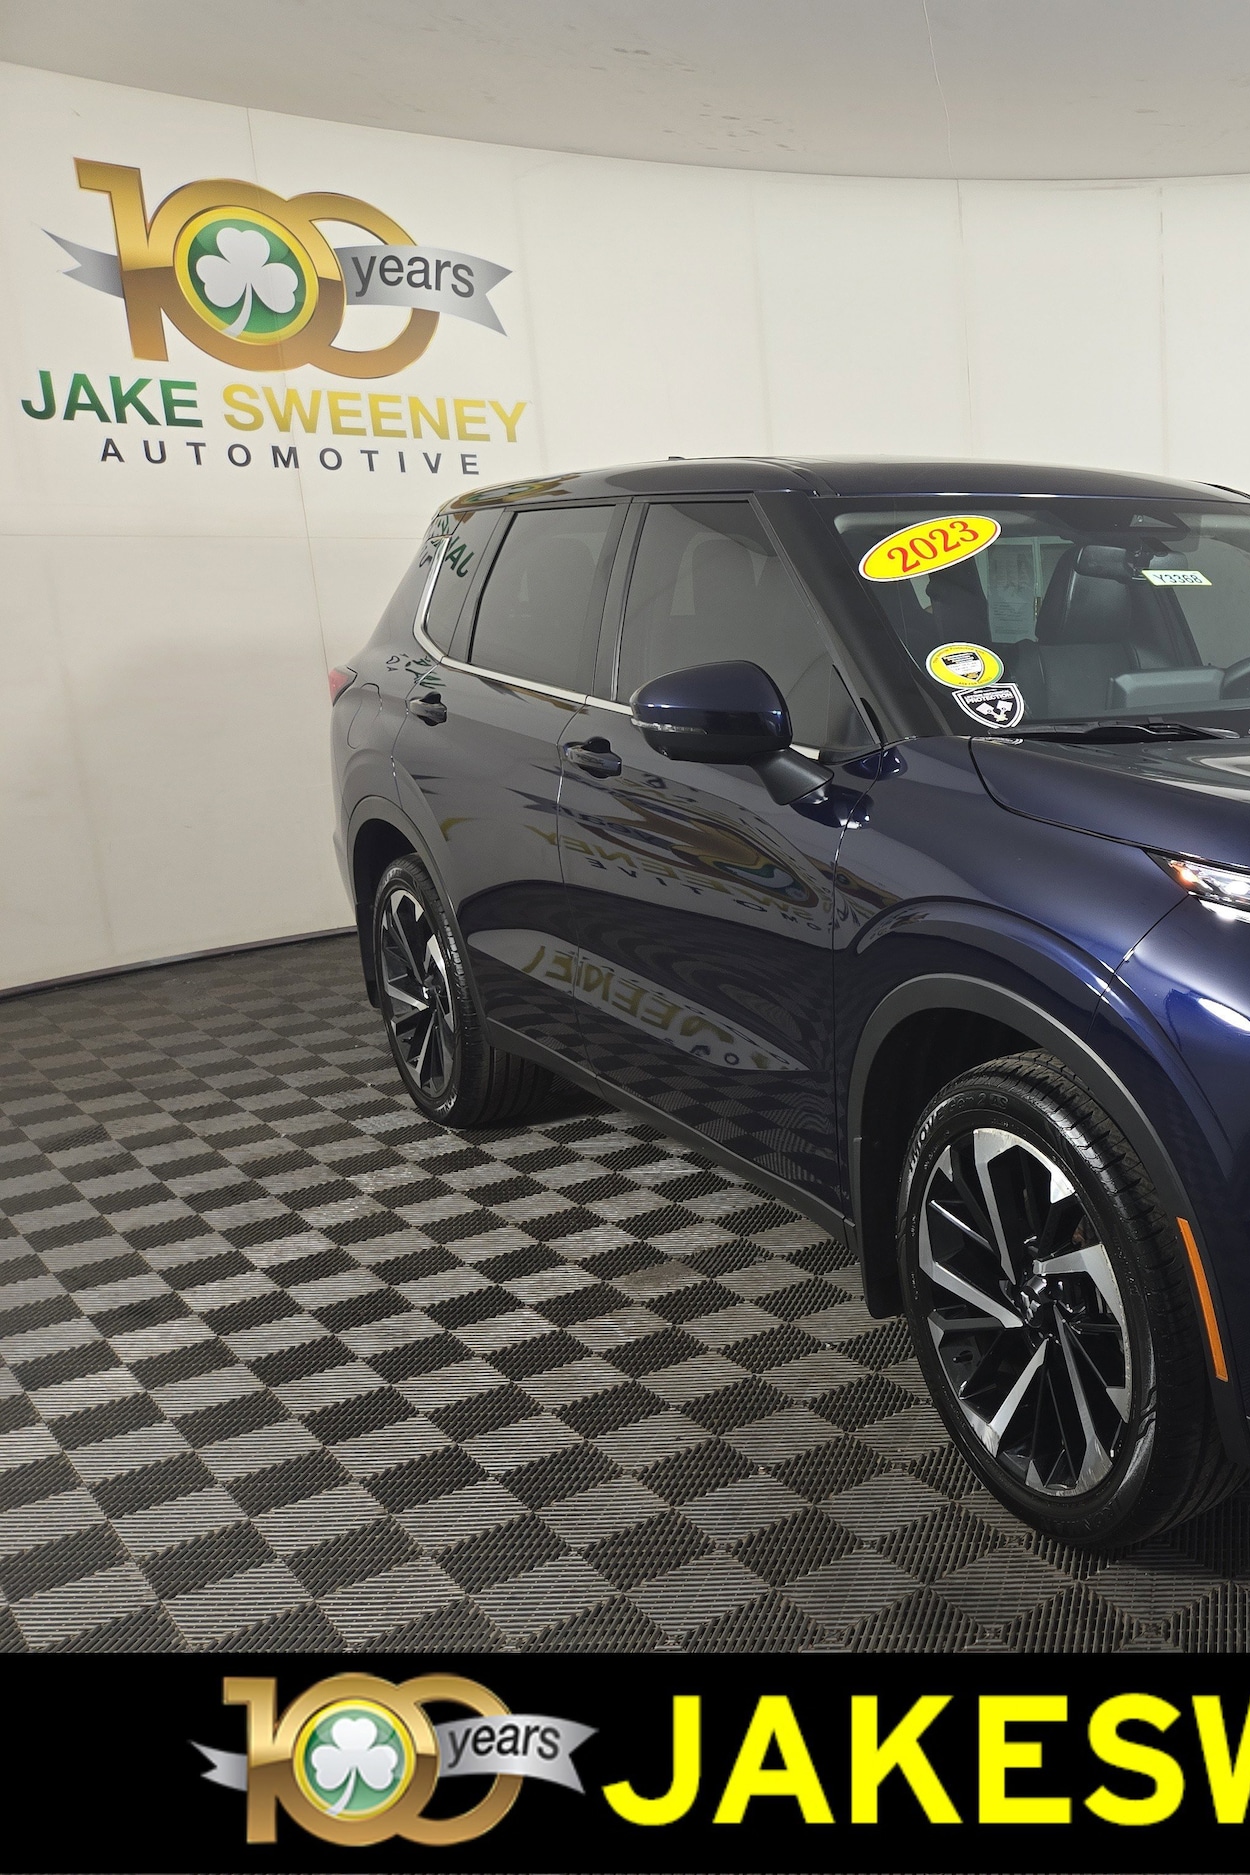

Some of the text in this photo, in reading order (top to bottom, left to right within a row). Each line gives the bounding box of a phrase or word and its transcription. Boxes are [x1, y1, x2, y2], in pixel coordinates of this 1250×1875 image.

[351, 254, 475, 297] years
[21, 369, 528, 443] JAKE SWEENEY
[100, 438, 480, 475] AUTOMOTIVE
[887, 520, 979, 573] 2023
